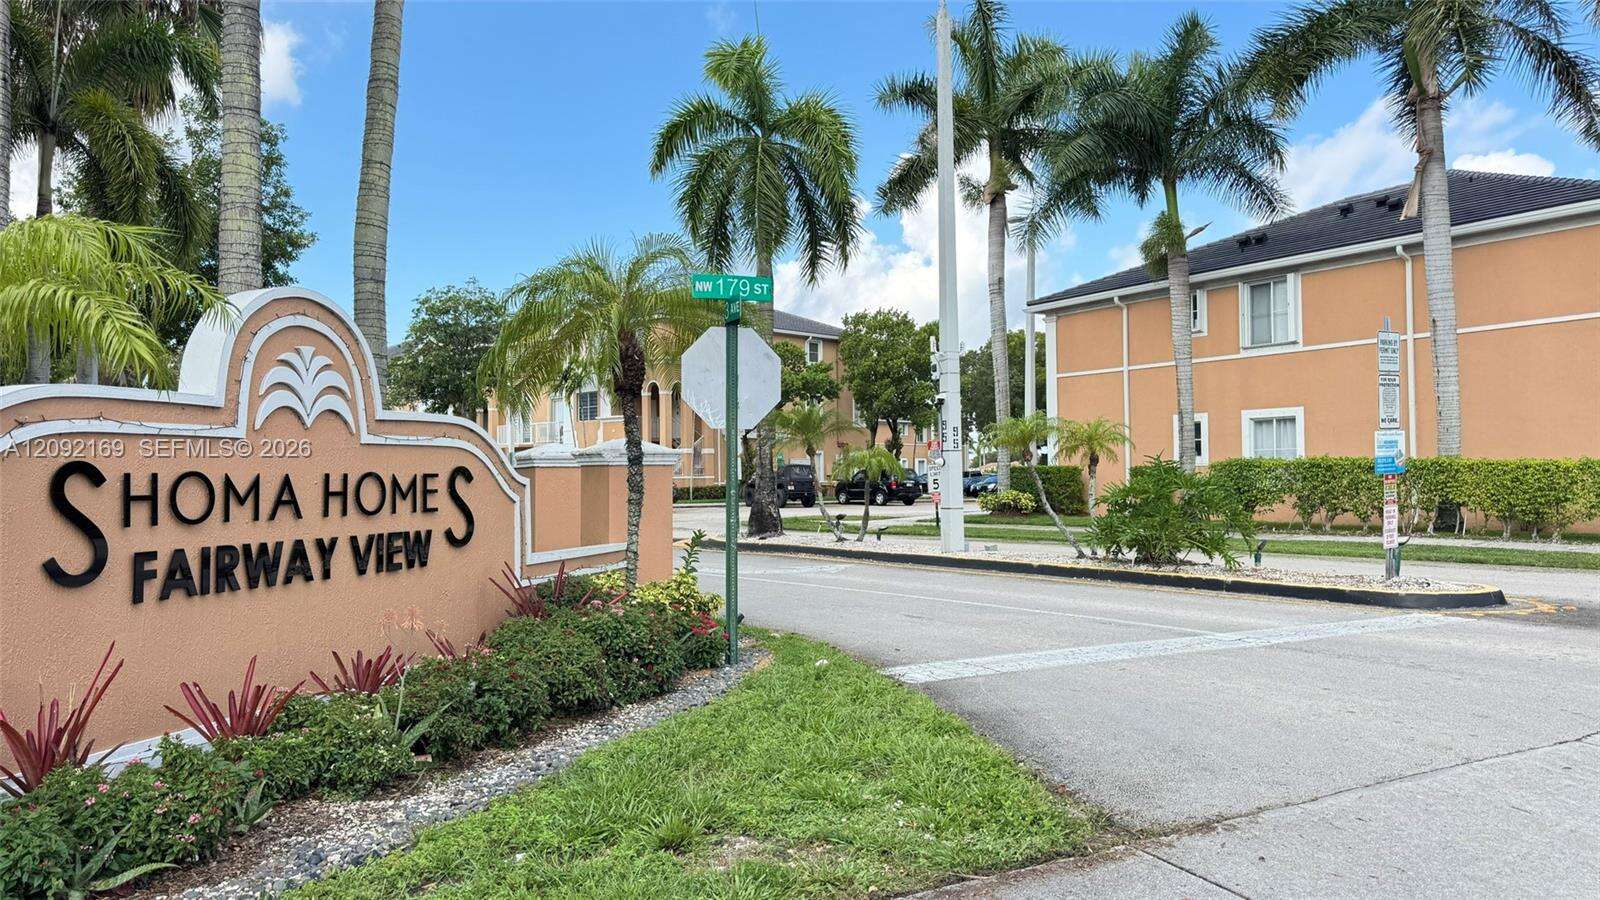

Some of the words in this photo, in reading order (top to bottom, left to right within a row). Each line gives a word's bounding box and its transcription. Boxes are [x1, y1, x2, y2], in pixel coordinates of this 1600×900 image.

[695, 281, 713, 292] NW
[716, 277, 750, 297] 179
[753, 283, 769, 295] ST
[933, 479, 940, 490] 5
[42, 460, 303, 588] SHOMA
[323, 466, 475, 548] HOMES
[131, 535, 338, 604] FAIRWAY
[350, 529, 432, 576] VIEW
